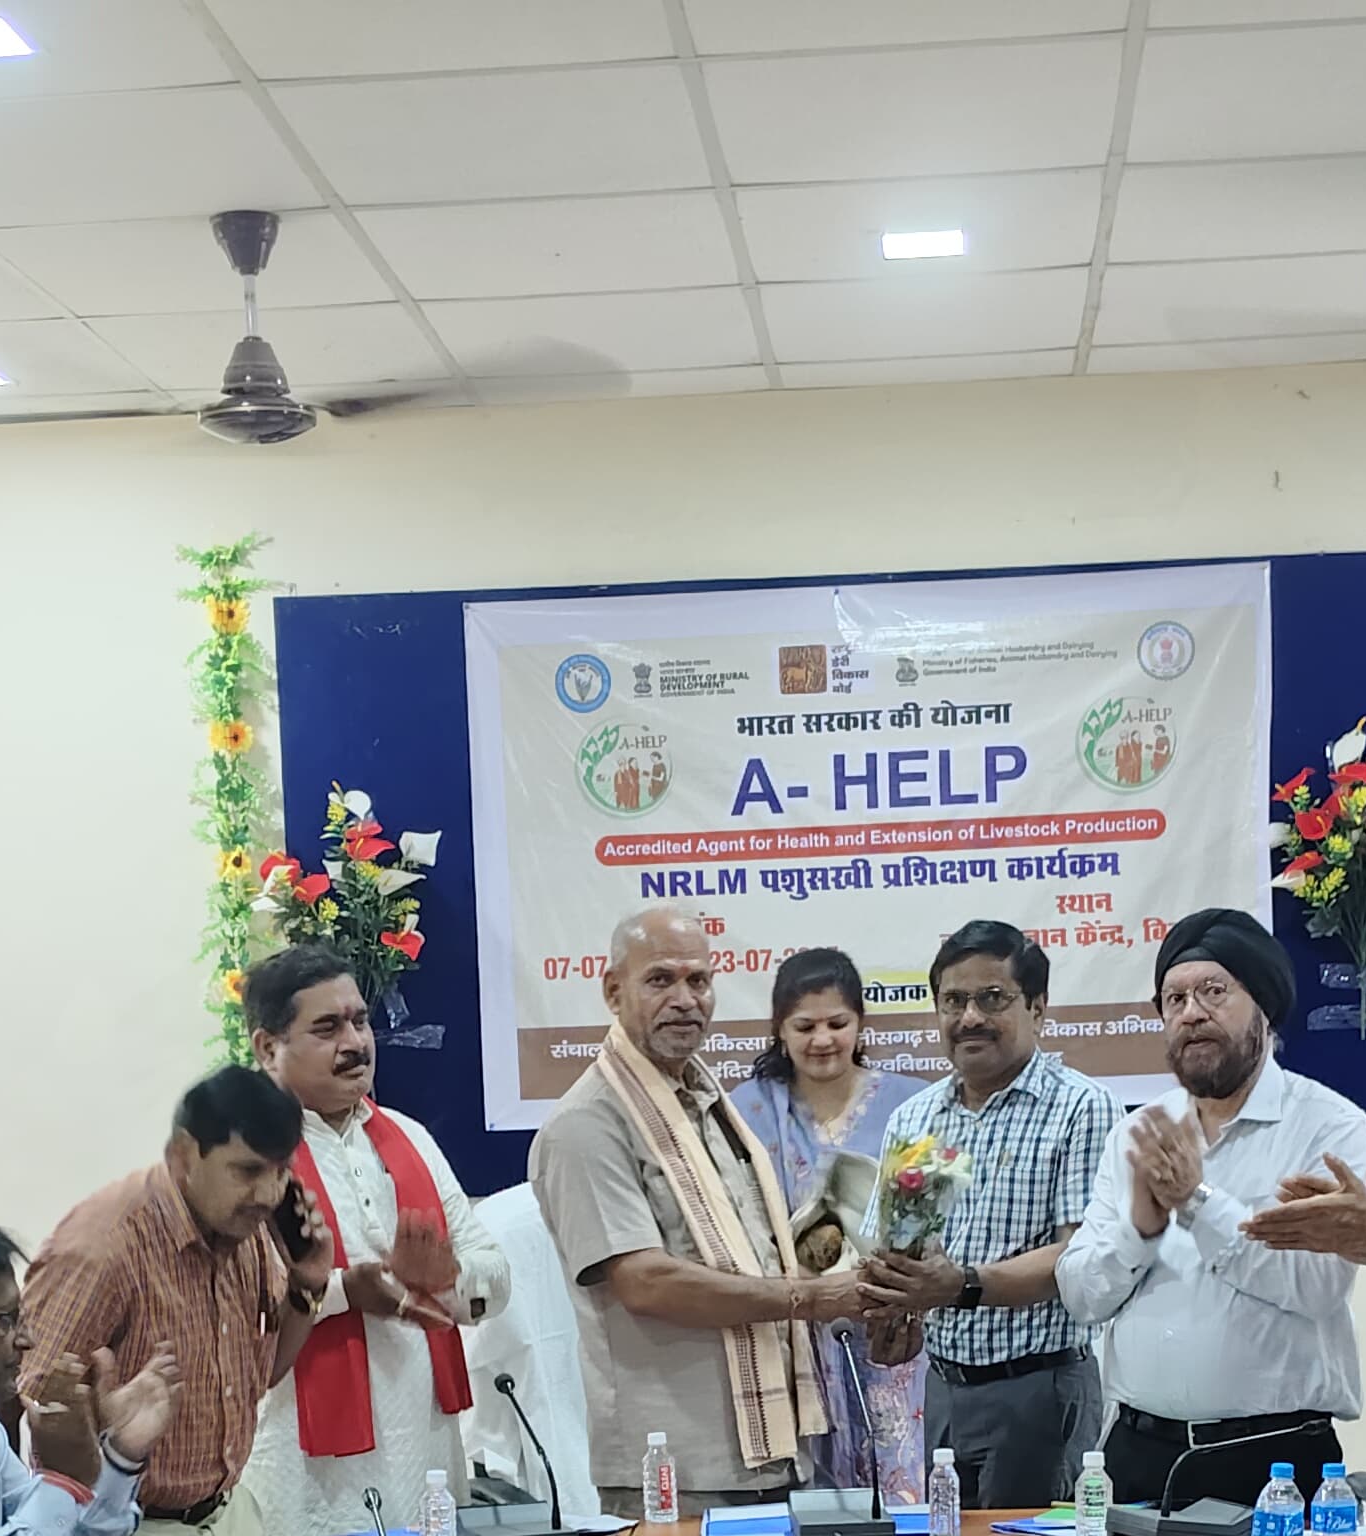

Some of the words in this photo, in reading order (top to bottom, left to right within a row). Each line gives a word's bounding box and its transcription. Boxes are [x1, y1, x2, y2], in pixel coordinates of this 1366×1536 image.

[923, 657, 954, 668] Ministry
[955, 656, 963, 665] of
[923, 666, 967, 676] Government
[969, 665, 977, 674] of
[659, 674, 698, 683] MINISTRY
[701, 673, 713, 682] OF
[719, 671, 750, 681] RURAL
[660, 681, 725, 692] DEVELOPMENT
[737, 713, 795, 737] भारत
[803, 710, 881, 733] सरकार
[889, 703, 922, 729] की
[931, 701, 1012, 726] योजना
[1121, 707, 1173, 724] A-HELP
[619, 734, 668, 750] A-HELP
[731, 758, 809, 816] A-
[833, 746, 1027, 811] HELP
[604, 837, 693, 857] Accredited
[695, 838, 745, 856] Agent
[749, 836, 773, 851] for
[777, 833, 830, 850] Health
[835, 831, 865, 847] and
[870, 826, 953, 845] Extension
[958, 824, 976, 841] of
[980, 820, 1060, 840] Livestock
[1065, 815, 1158, 834] Production
[641, 868, 747, 898] NRLM
[760, 859, 873, 900] पशुसखी
[882, 856, 997, 889] प्रशिक्षण
[1056, 892, 1113, 914] स्थान
[544, 955, 608, 980] 07-07
[862, 981, 928, 1003] योजक
[550, 1040, 603, 1059] संचाल
